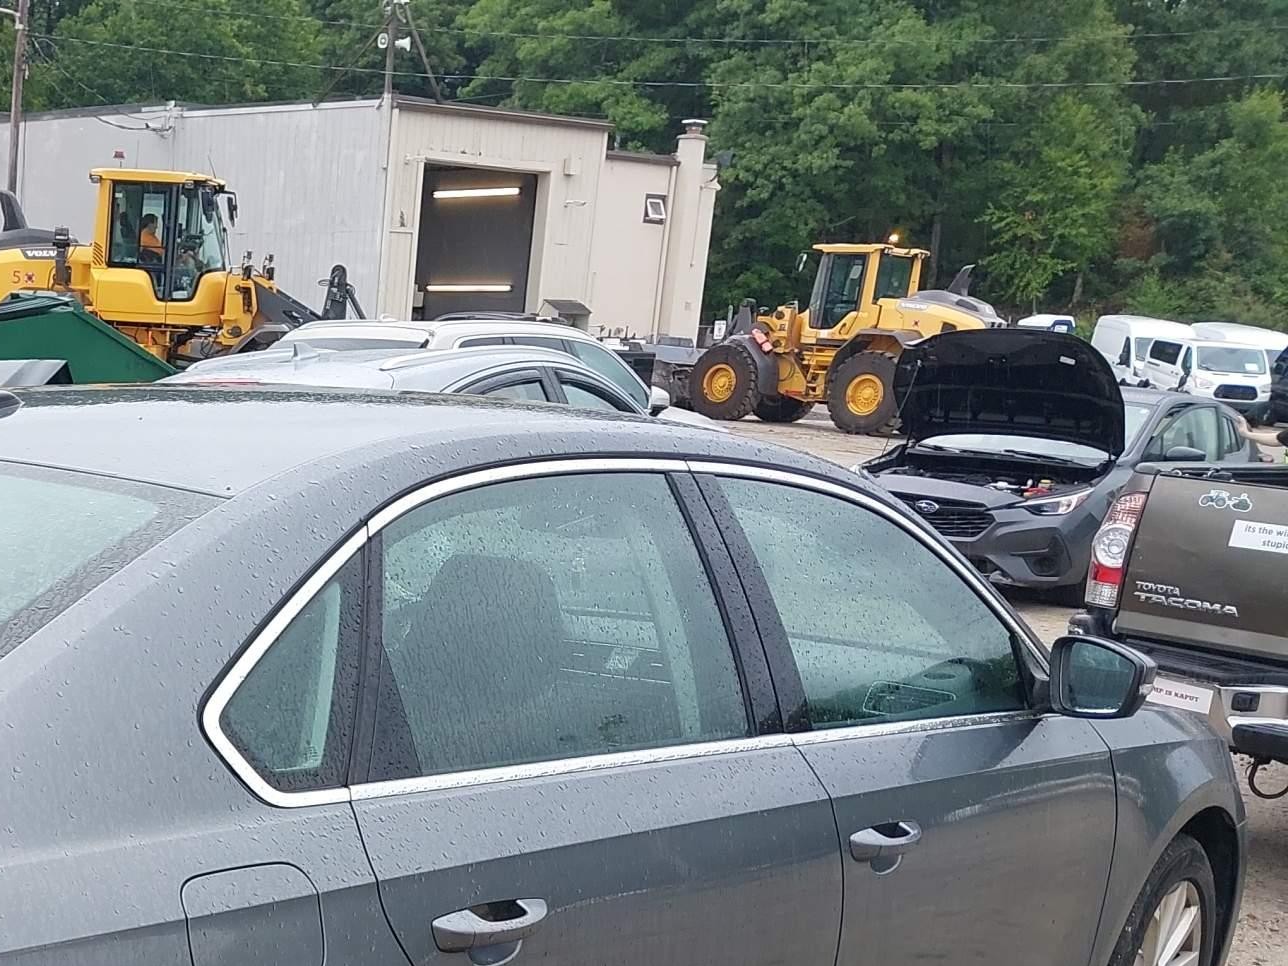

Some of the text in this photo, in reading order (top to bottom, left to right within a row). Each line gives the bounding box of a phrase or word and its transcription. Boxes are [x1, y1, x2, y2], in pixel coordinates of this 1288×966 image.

[1258, 526, 1273, 536] the
[1276, 529, 1288, 537] wi
[1136, 581, 1180, 596] TOYOTA
[1133, 591, 1239, 617] TACOMA
